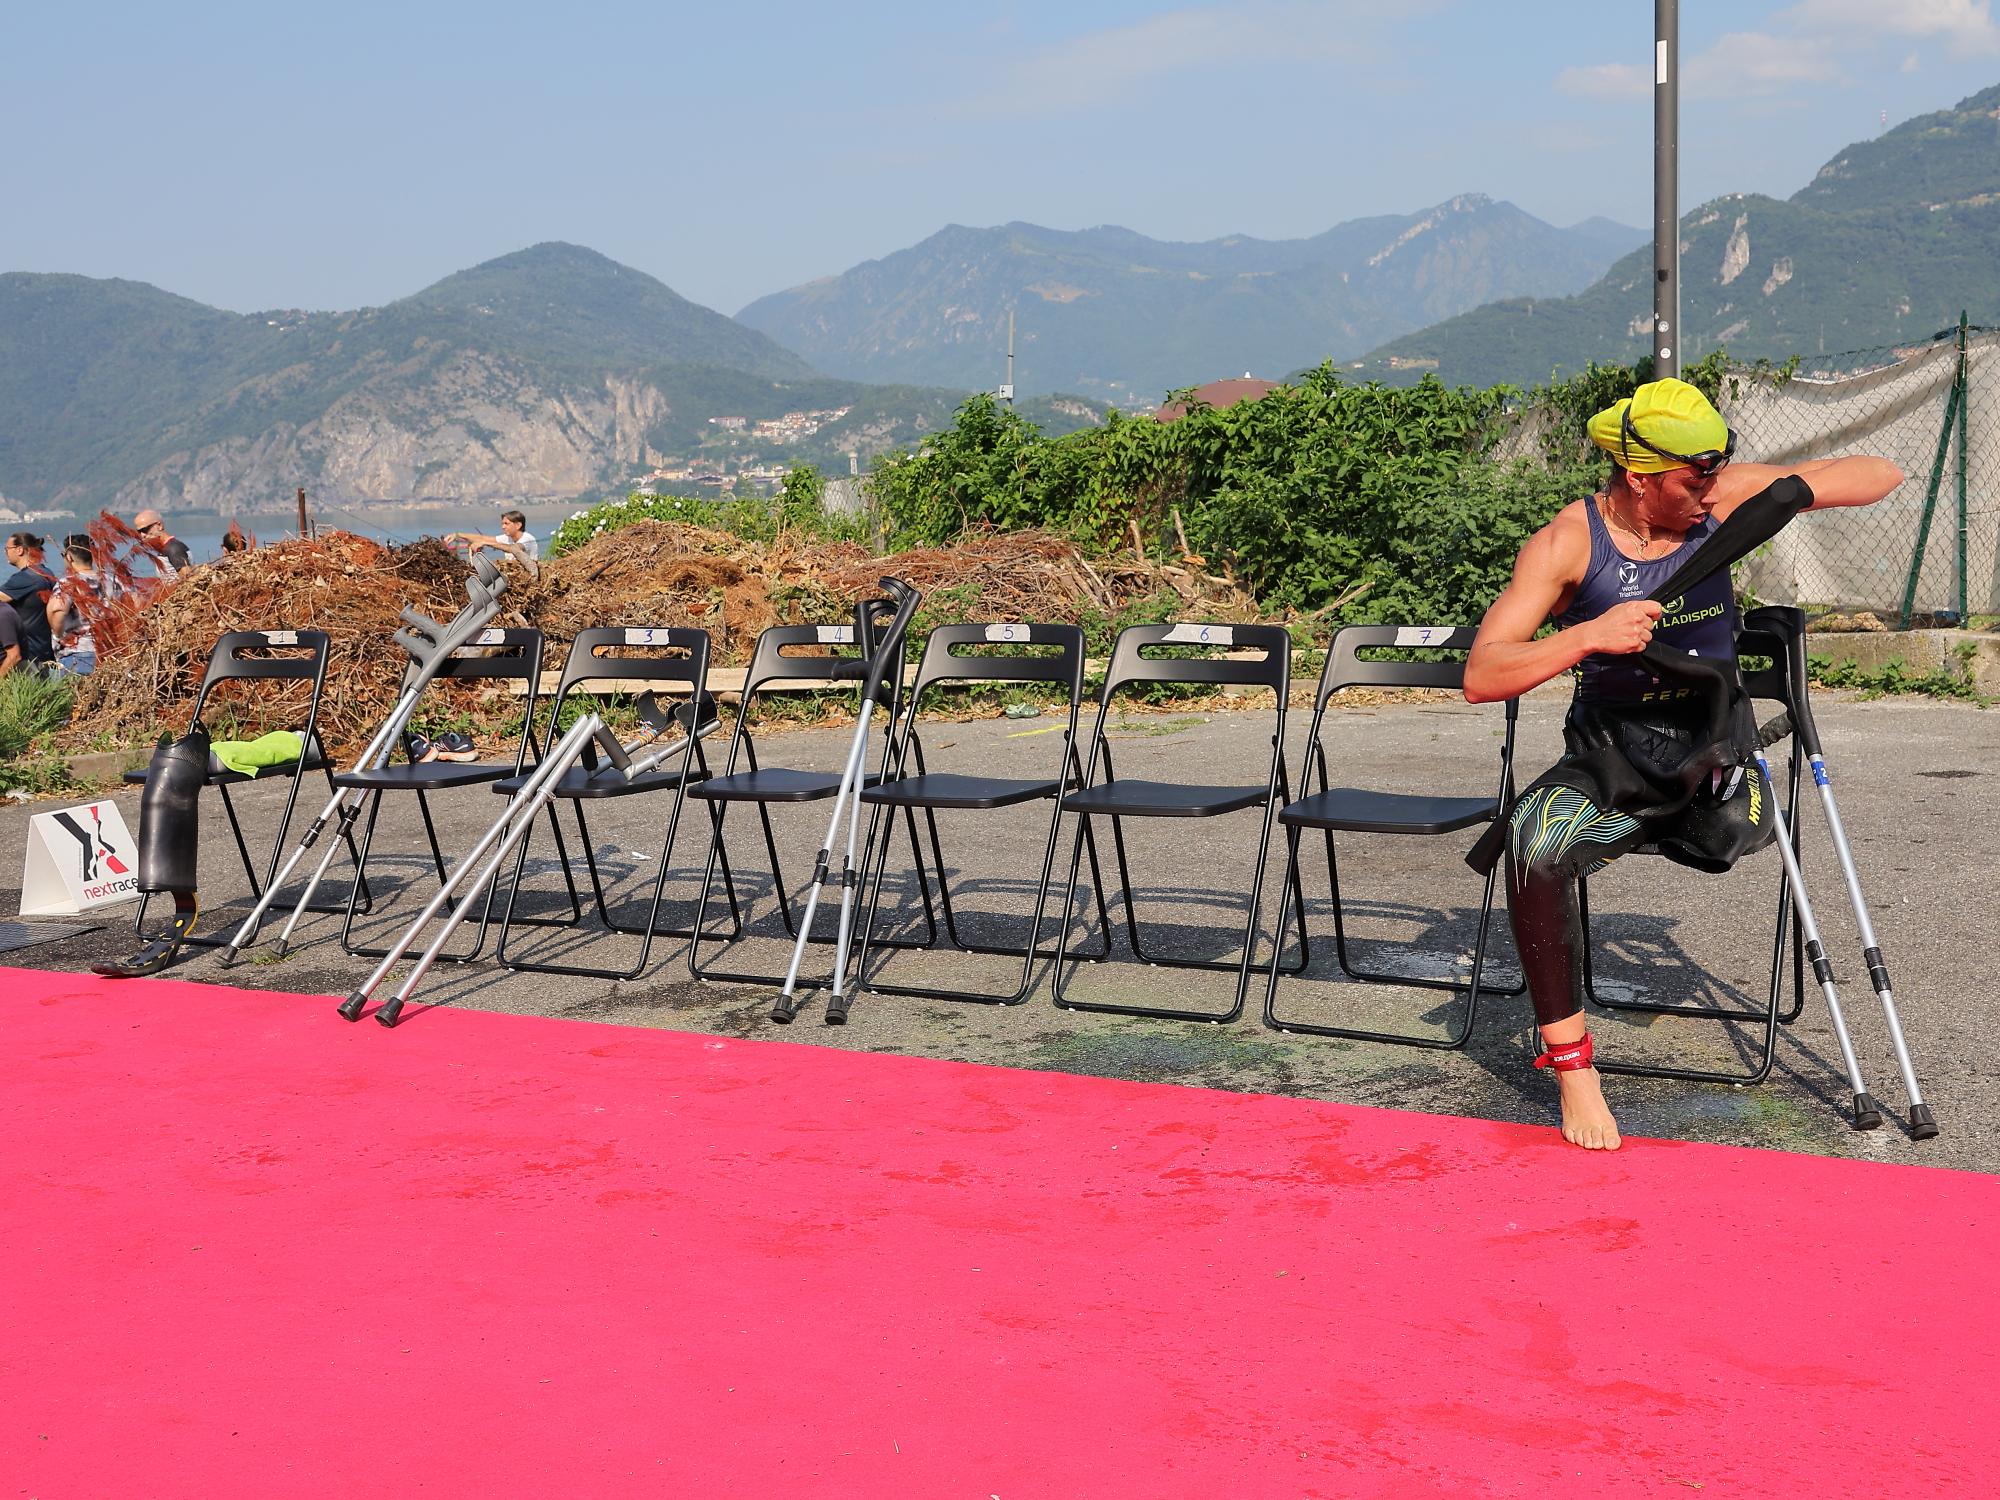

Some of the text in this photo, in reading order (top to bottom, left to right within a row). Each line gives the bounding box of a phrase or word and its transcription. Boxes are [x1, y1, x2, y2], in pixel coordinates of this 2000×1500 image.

[1618, 590, 1644, 598] Triathlon
[1622, 584, 1639, 592] World
[1662, 603, 1725, 628] LADISPOLI
[278, 632, 285, 643] 1
[482, 630, 492, 642] 2
[643, 629, 653, 643] 3
[834, 626, 844, 642] 4
[1003, 626, 1014, 640] 5
[1200, 626, 1210, 641] 6
[1419, 629, 1432, 644] 7
[83, 877, 139, 900] nextrace
